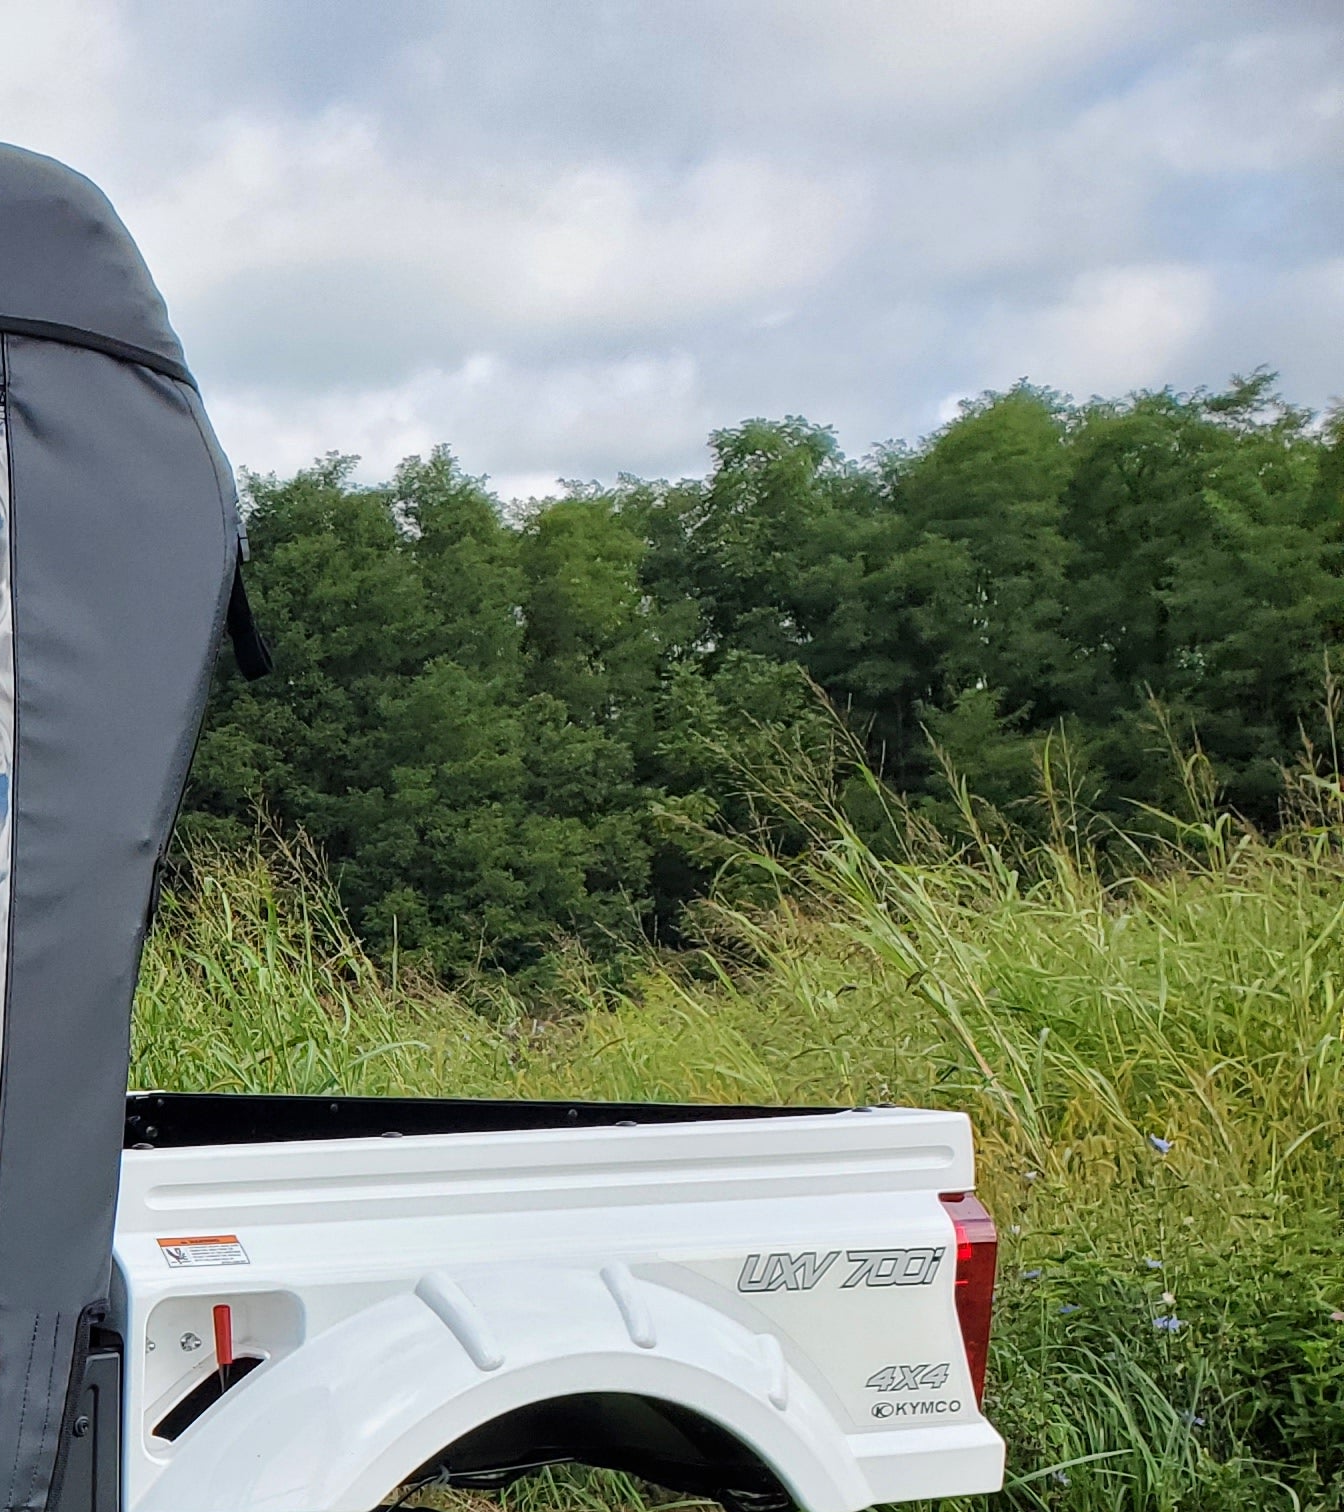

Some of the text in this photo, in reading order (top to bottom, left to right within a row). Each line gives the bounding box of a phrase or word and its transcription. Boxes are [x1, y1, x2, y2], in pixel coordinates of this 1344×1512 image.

[737, 1247, 946, 1293] UXV 700i
[865, 1363, 950, 1392] 4X4
[895, 1400, 961, 1416] KYMCO
